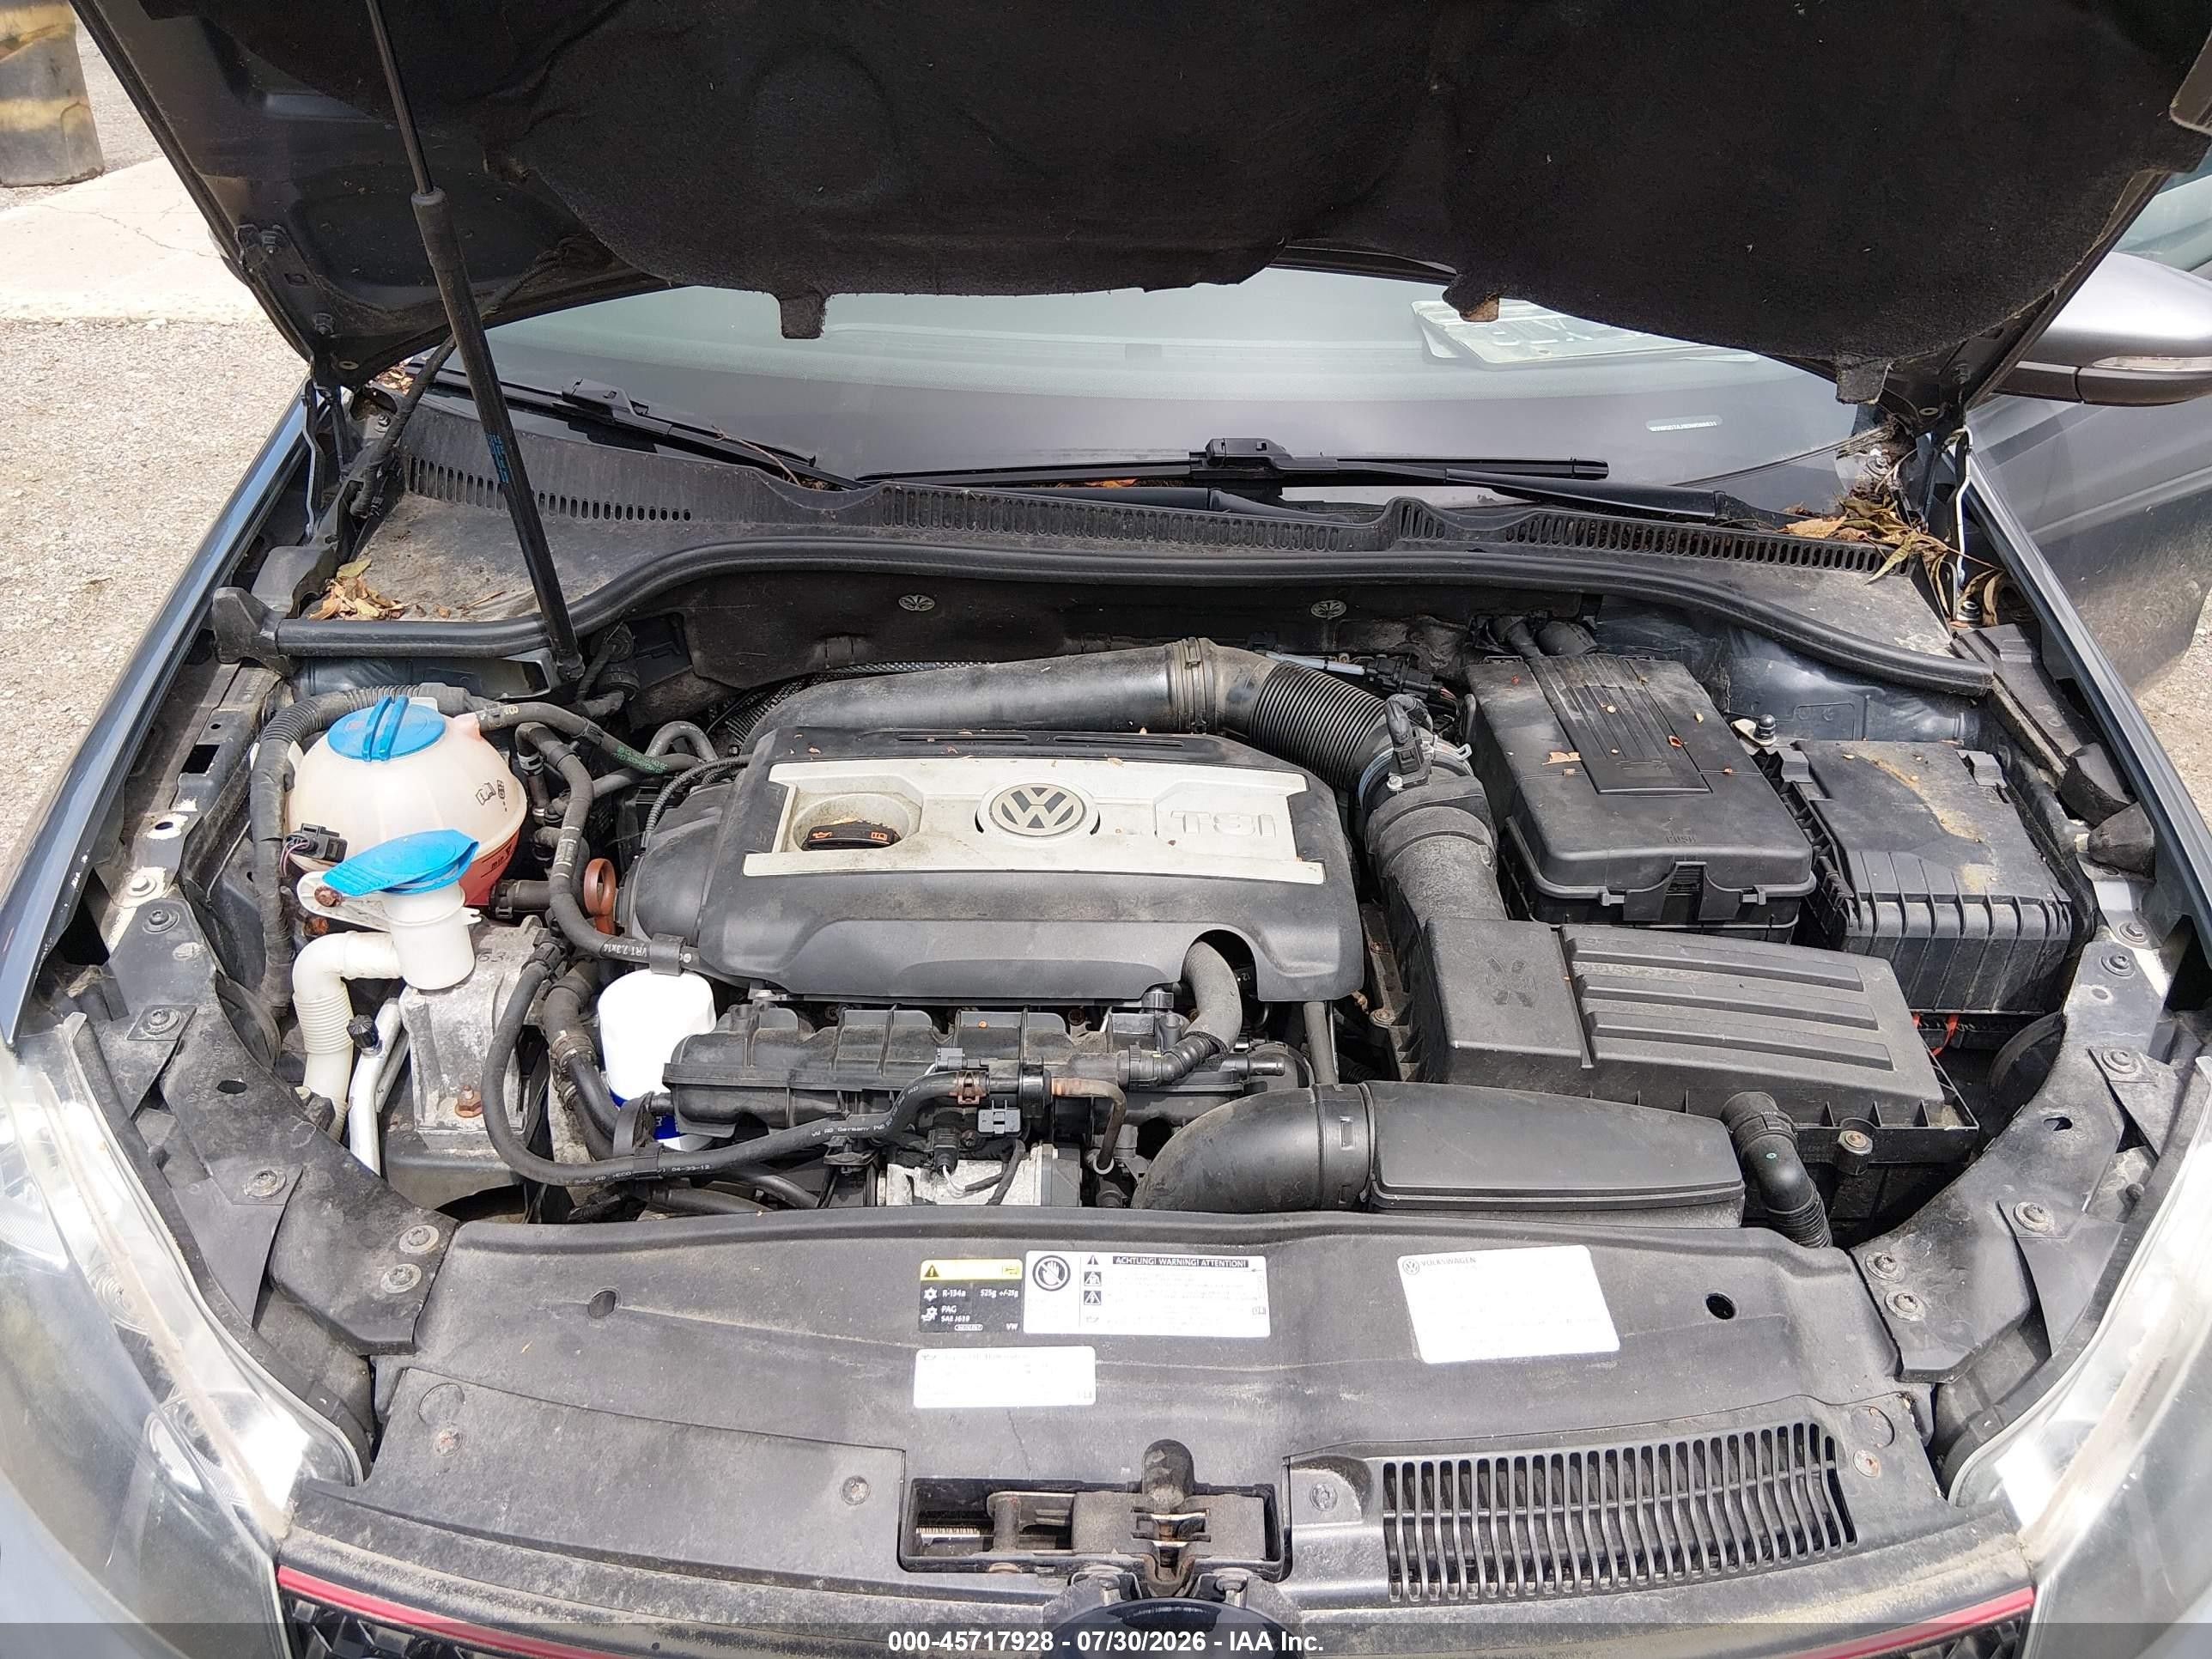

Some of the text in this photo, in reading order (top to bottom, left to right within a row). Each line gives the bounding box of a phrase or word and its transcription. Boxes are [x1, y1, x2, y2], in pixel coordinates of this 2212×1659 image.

[1170, 810, 1277, 838] TSI
[1115, 1256, 1246, 1268] ACHTUNG! WARNING! ATTENTION!
[942, 1289, 966, 1297] R-134a
